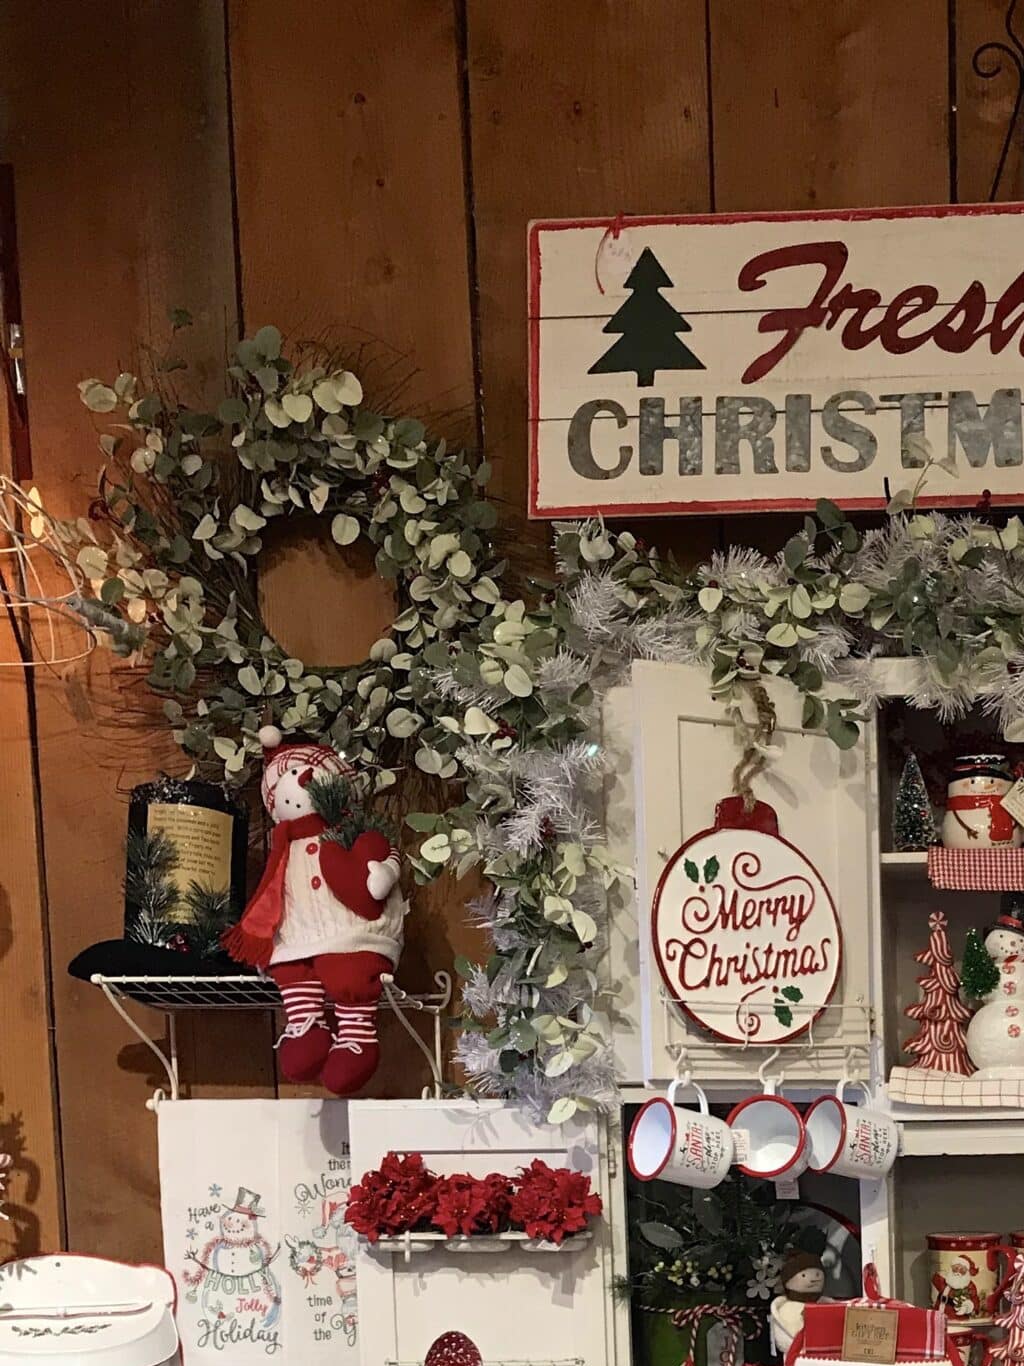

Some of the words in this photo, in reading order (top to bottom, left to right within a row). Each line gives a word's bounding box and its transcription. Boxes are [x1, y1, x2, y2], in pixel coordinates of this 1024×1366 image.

[682, 876, 814, 941] Merry
[665, 937, 831, 991] Christmas
[188, 1203, 221, 1224] Have
[205, 1221, 214, 1231] a
[236, 1298, 269, 1317] Jolly
[307, 1295, 332, 1308] time
[315, 1311, 327, 1323] of
[197, 1318, 282, 1355] Holiday
[314, 1328, 332, 1341] the
